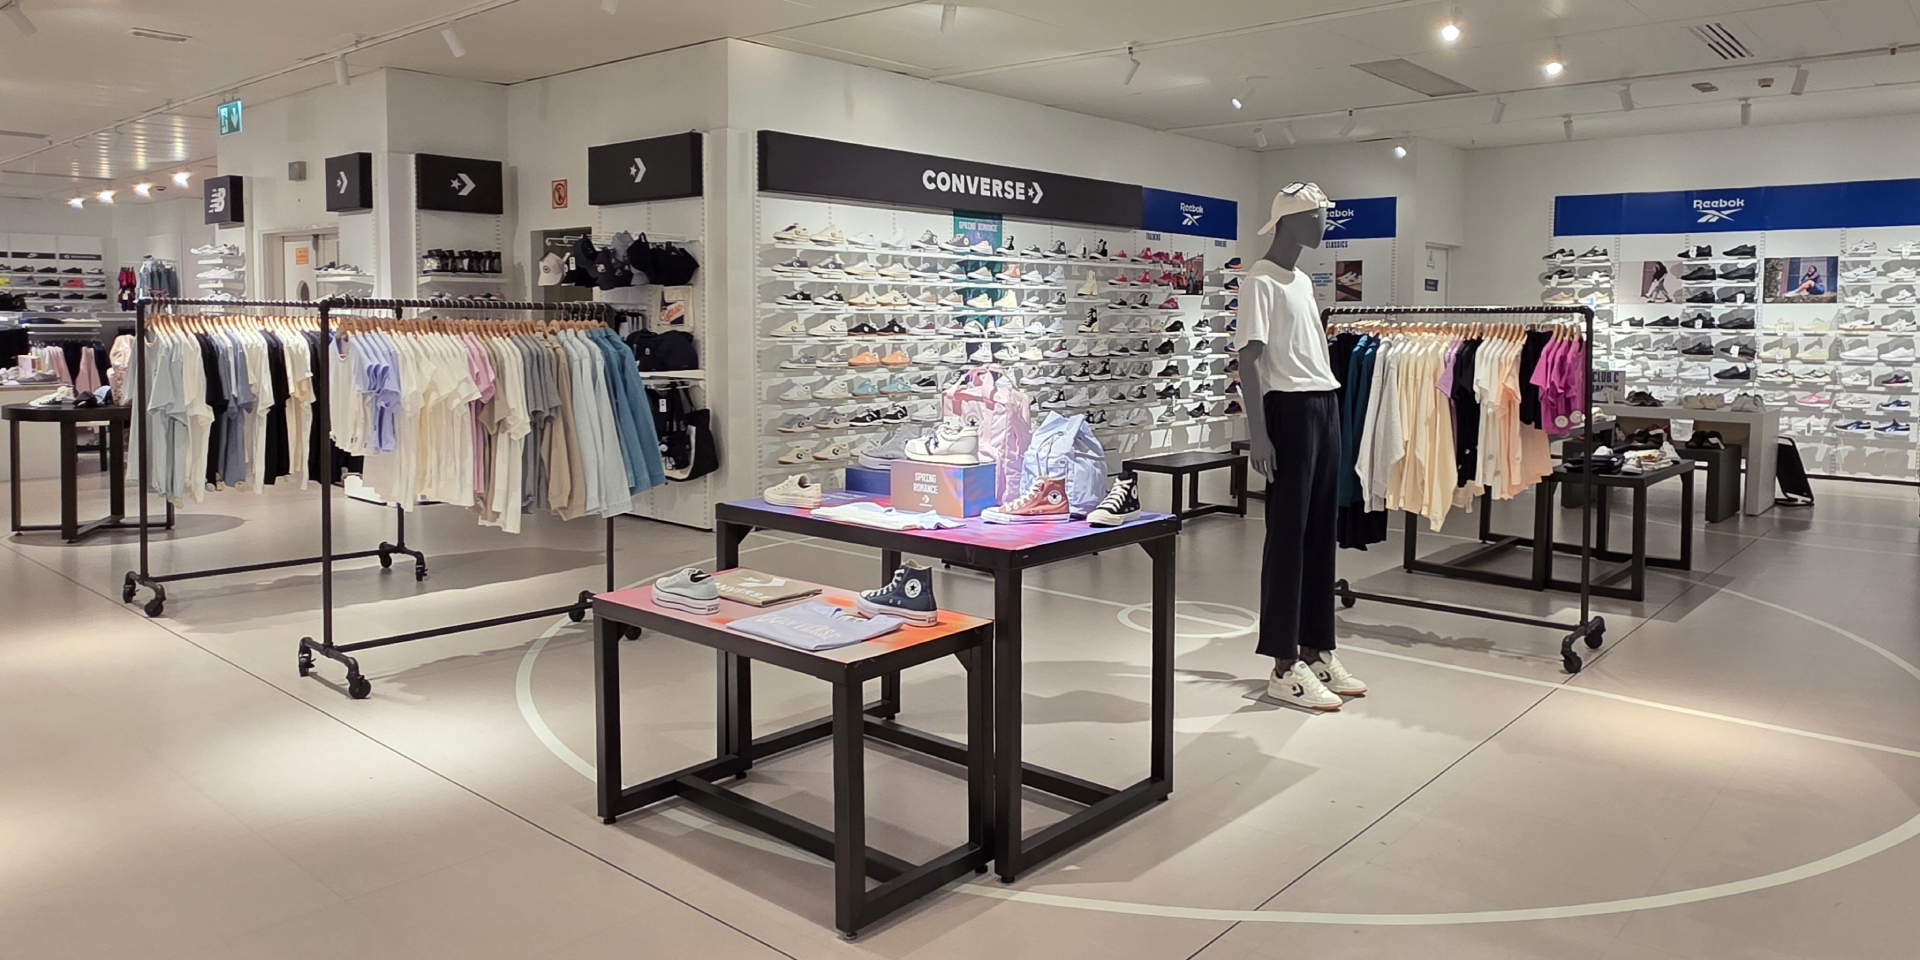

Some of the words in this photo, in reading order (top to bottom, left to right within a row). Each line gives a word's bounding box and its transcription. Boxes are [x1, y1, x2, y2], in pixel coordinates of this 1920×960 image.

[922, 169, 1025, 200] CONVERSE
[1180, 202, 1203, 214] Reebok
[1693, 198, 1745, 209] Reebok
[1326, 208, 1354, 217] ebok
[1614, 371, 1619, 383] C
[914, 472, 937, 483] SPRING
[913, 483, 938, 494] ROMANCE
